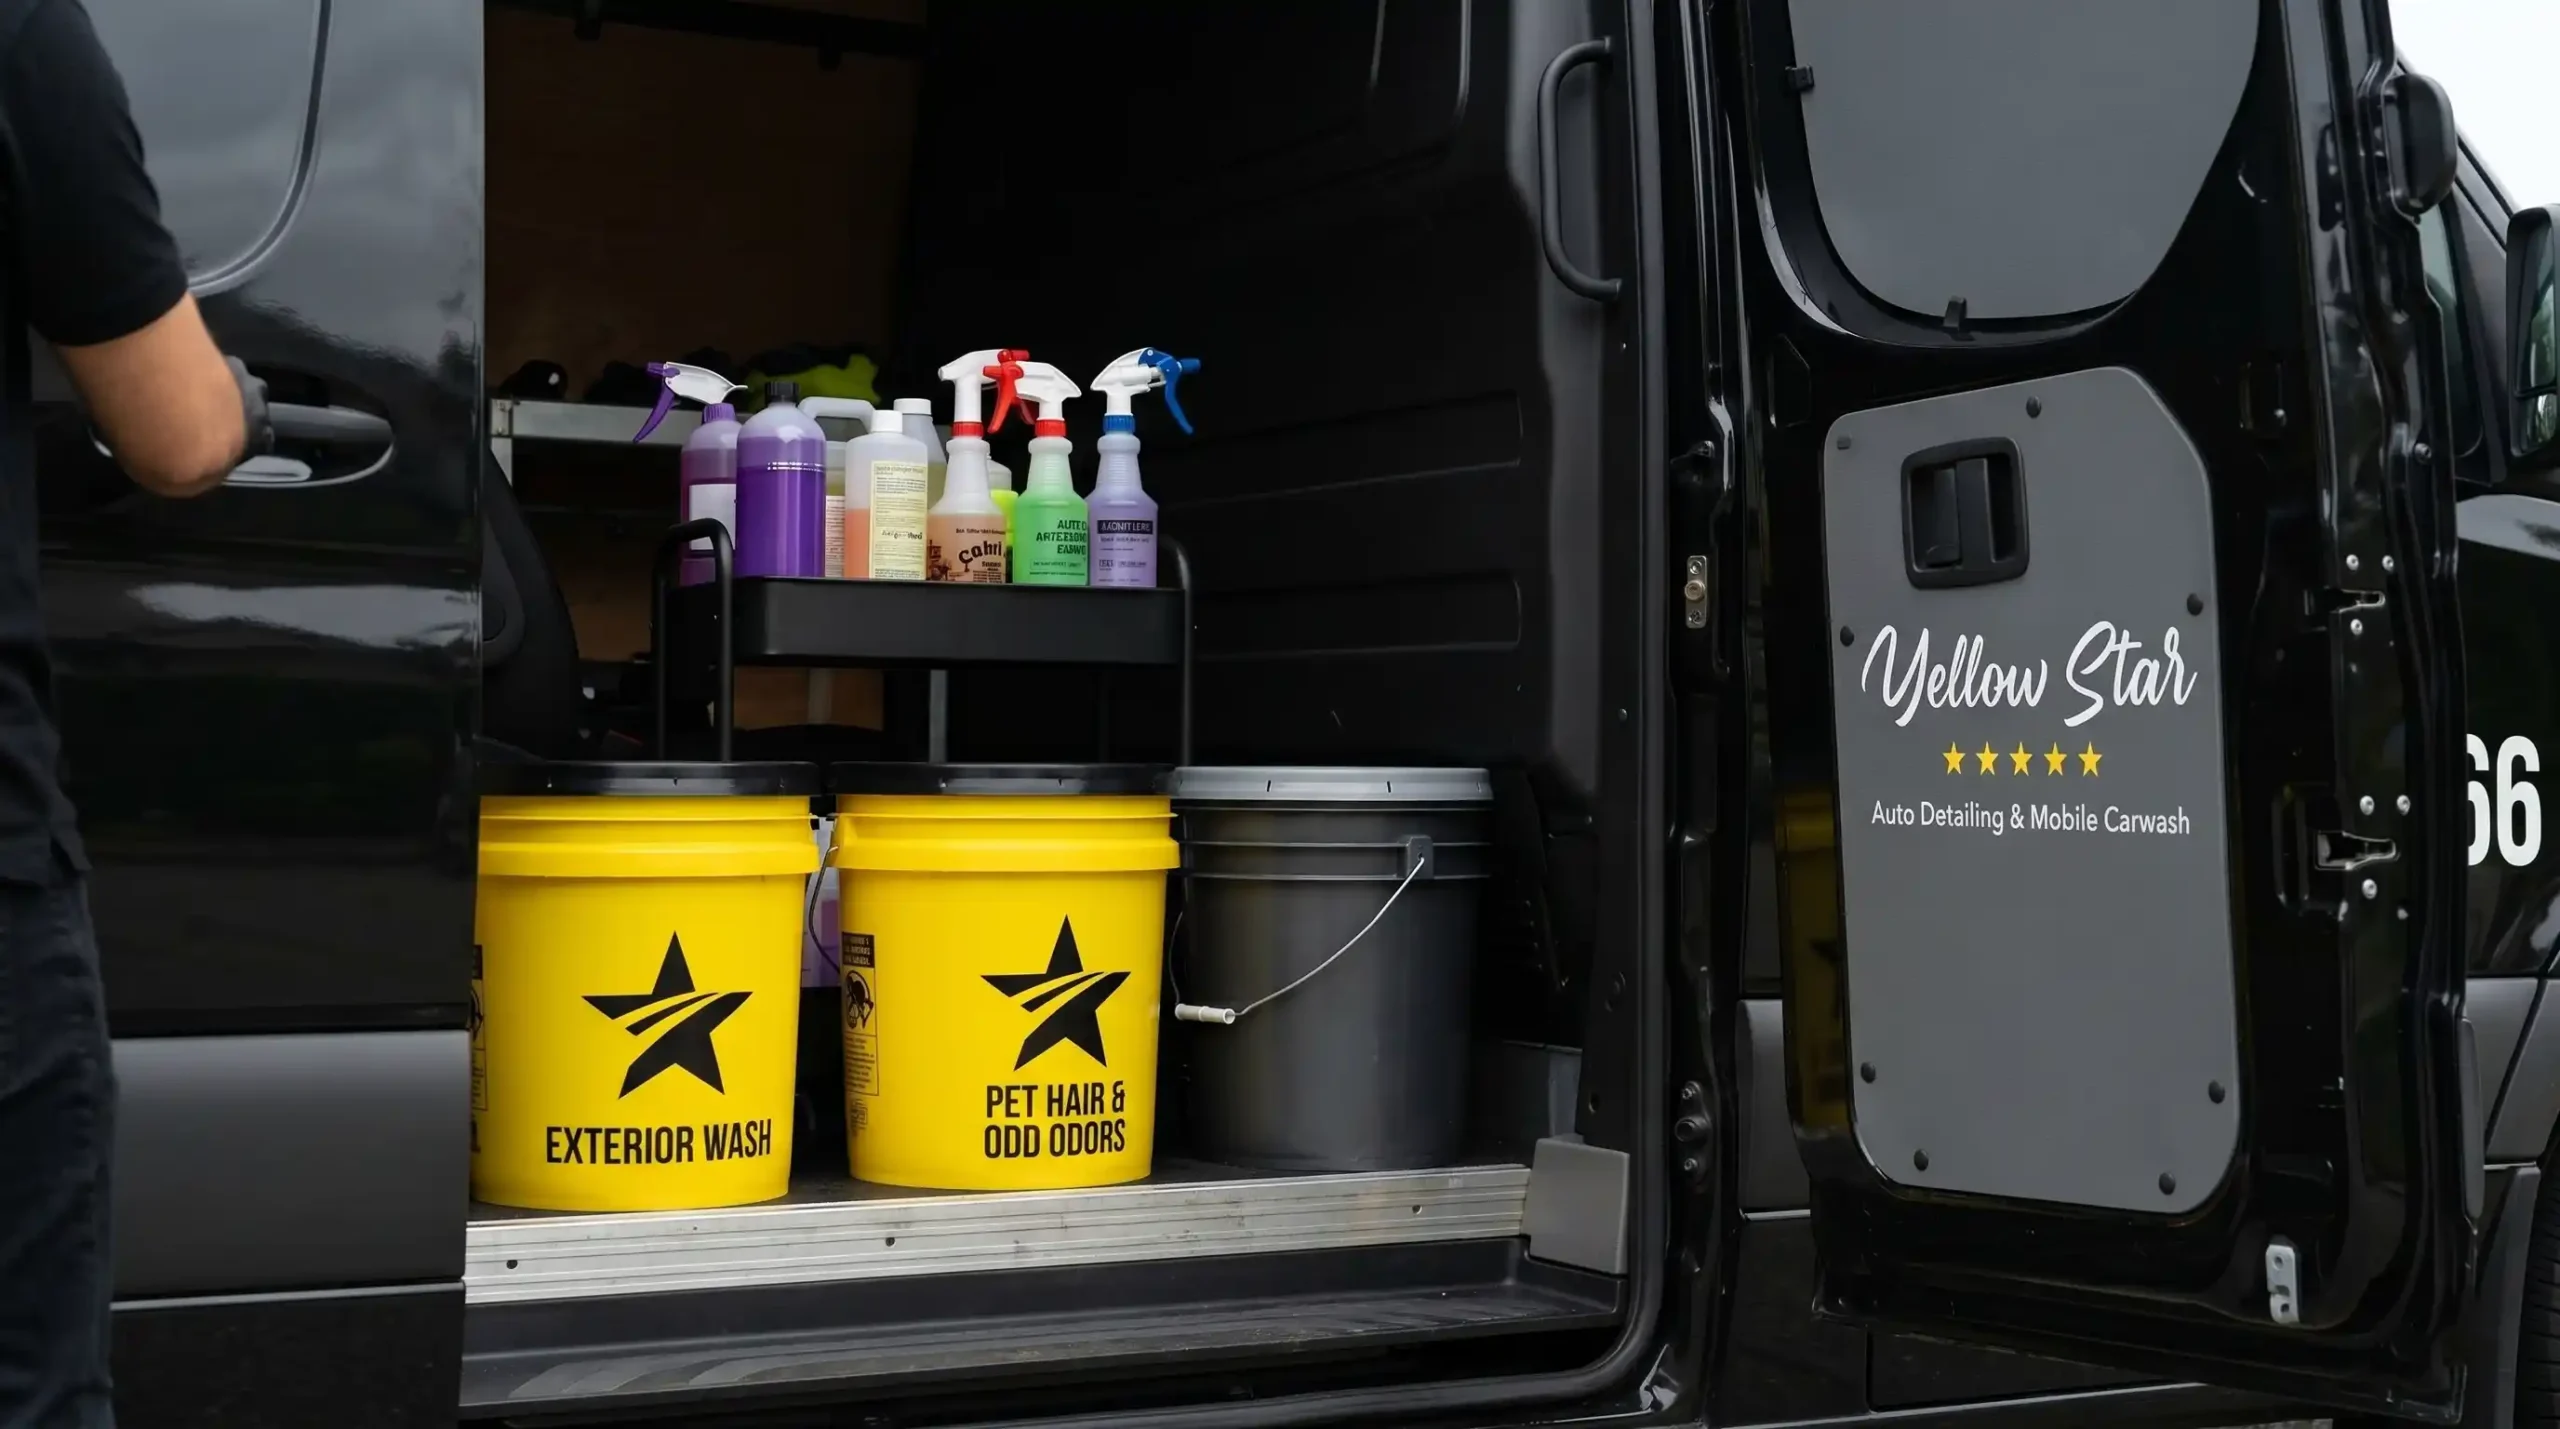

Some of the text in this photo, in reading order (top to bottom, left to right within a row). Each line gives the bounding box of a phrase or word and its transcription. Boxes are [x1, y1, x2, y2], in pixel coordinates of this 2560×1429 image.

[1861, 620, 2198, 728] Yellow Star
[1871, 800, 2190, 836] Auto Detailing & Mobile Carwash
[986, 1080, 1126, 1118] PET HAIR &
[546, 1119, 772, 1164] EXTERIOR WASH
[984, 1119, 1126, 1159] ODD ODORS
